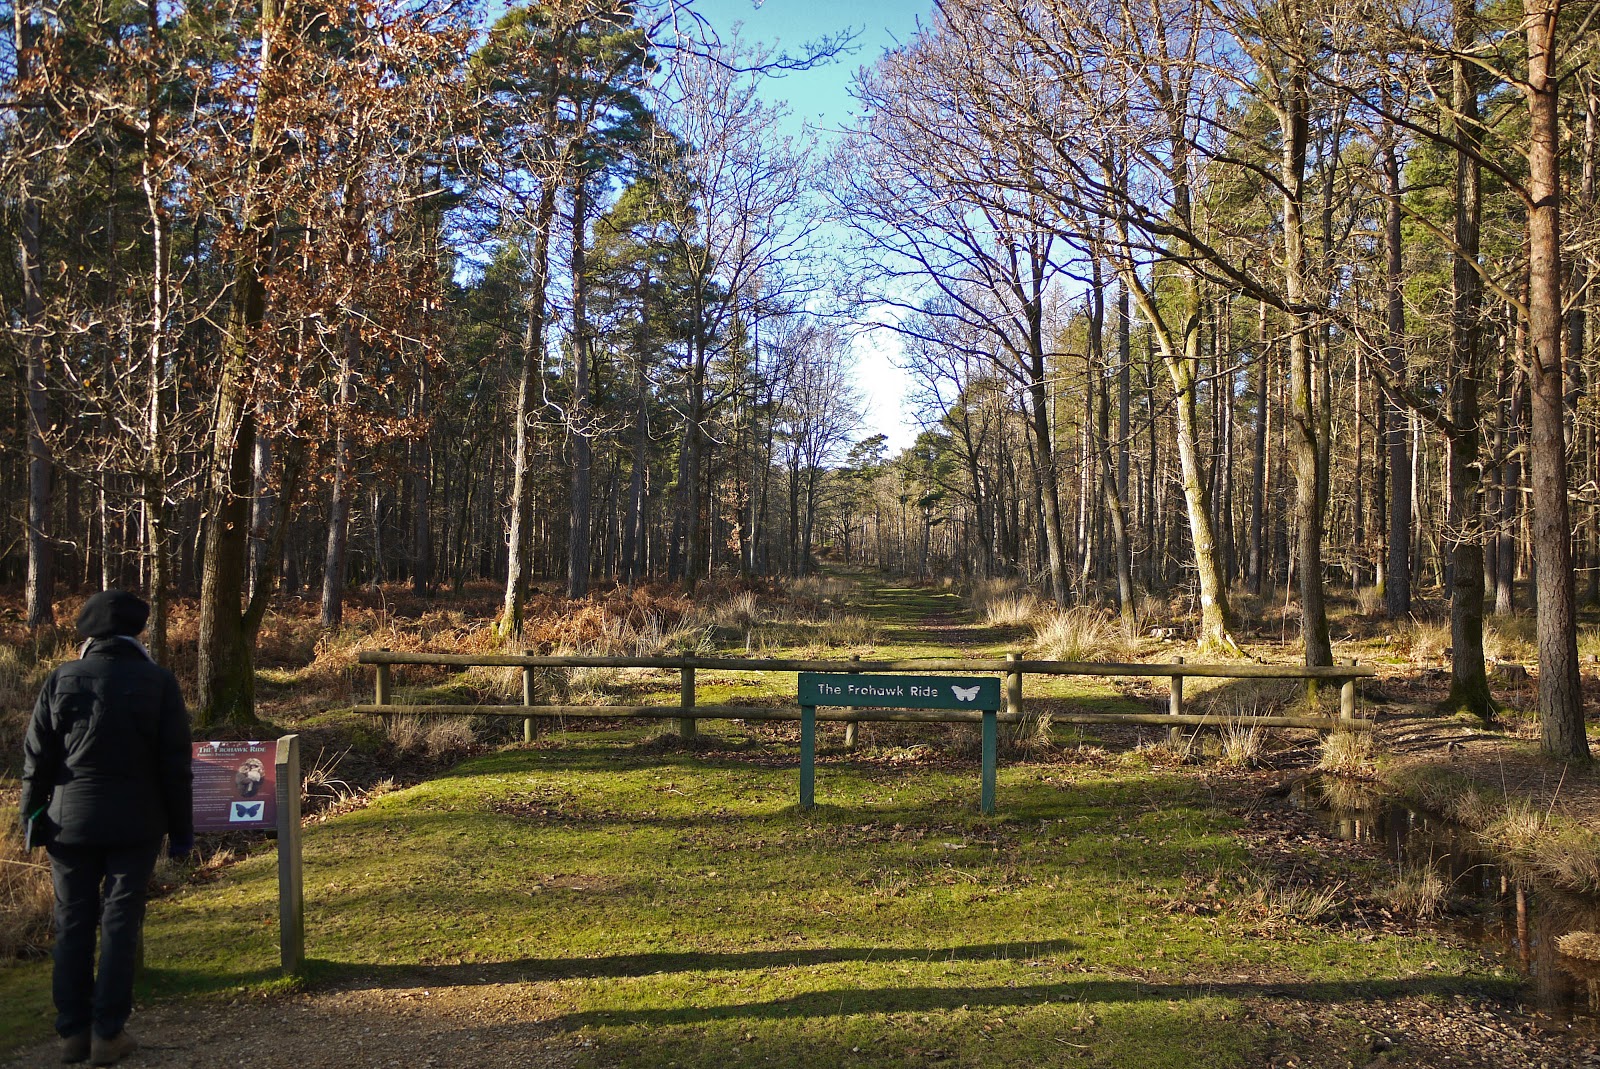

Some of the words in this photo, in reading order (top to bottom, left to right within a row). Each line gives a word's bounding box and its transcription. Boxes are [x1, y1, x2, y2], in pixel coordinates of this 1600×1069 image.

[817, 683, 842, 695] The
[847, 684, 904, 697] Frohawk
[910, 686, 938, 698] Ride
